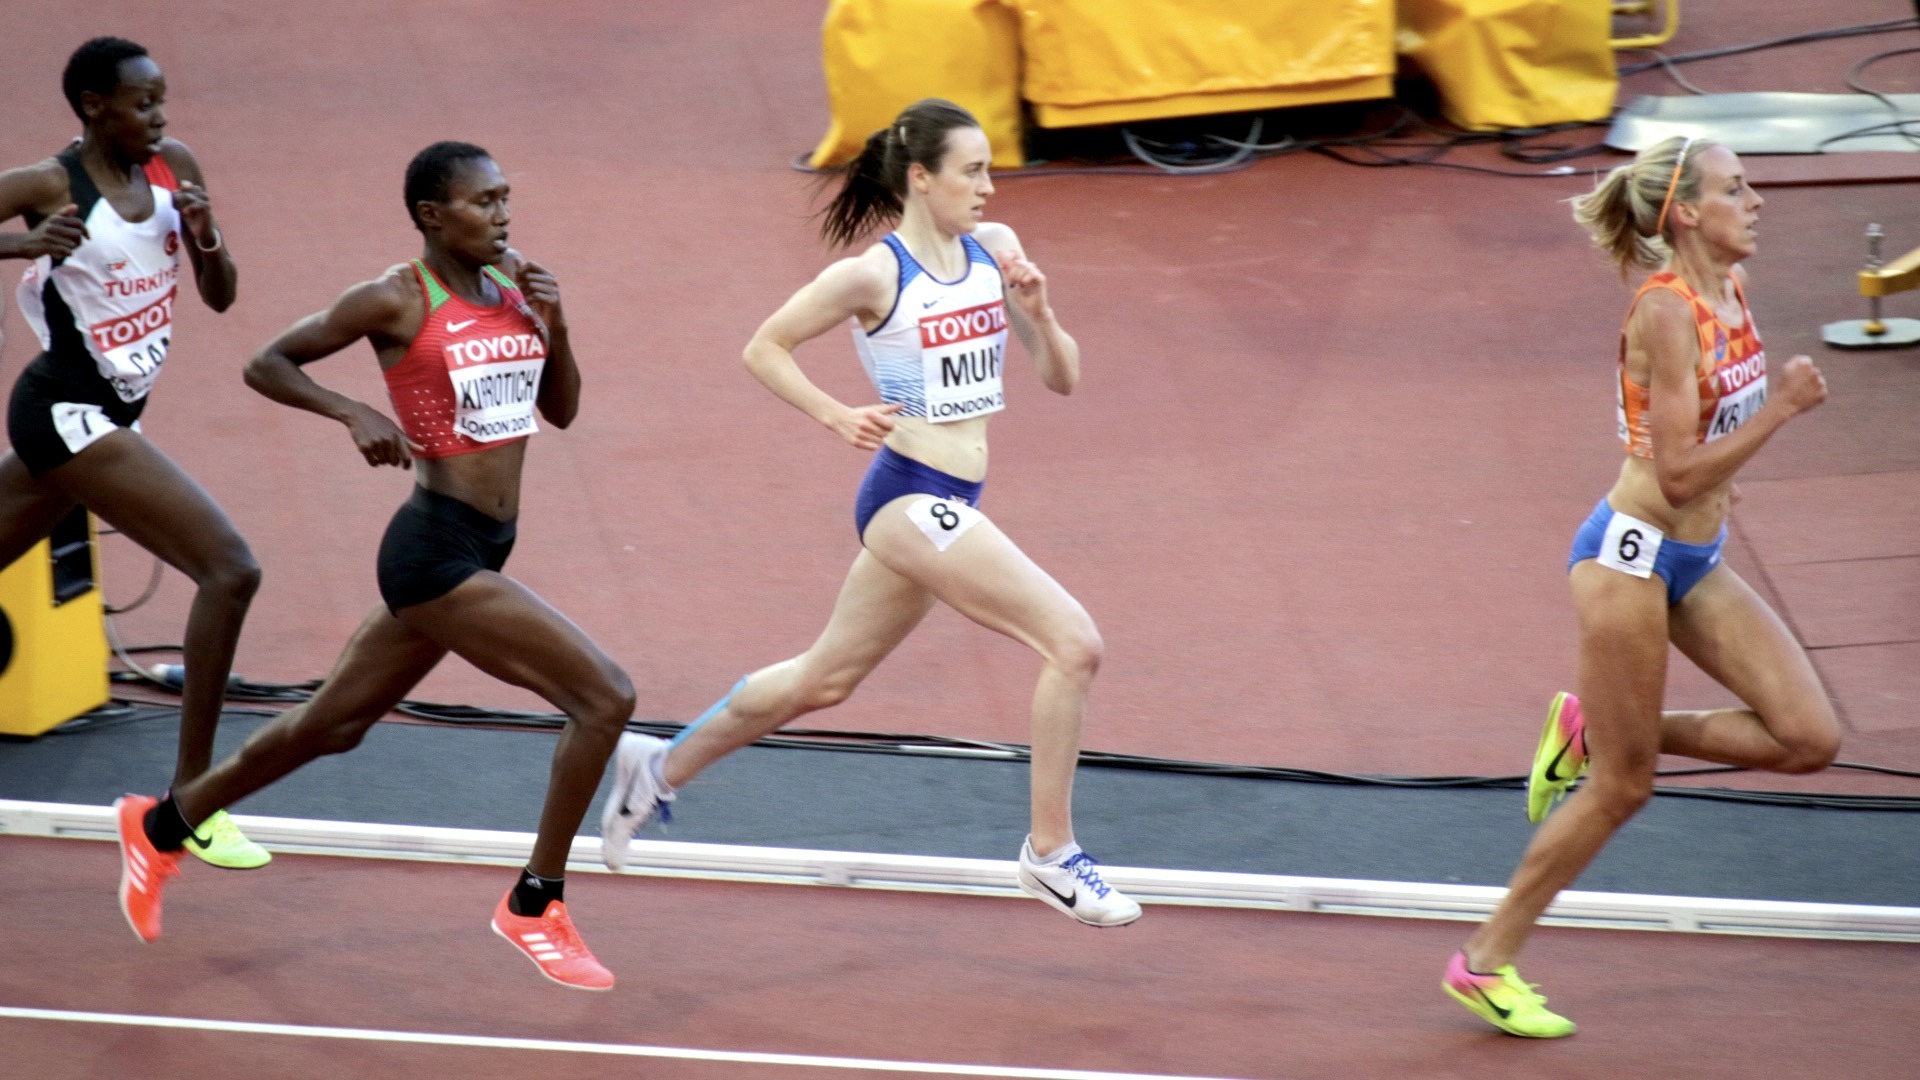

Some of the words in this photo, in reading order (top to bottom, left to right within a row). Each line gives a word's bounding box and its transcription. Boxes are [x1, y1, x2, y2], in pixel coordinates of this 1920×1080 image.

[94, 297, 172, 348] TOYOT
[129, 337, 169, 377] CA
[446, 334, 544, 365] TOYOTA
[931, 394, 997, 417] LONDON
[461, 417, 509, 436] LONDON
[930, 502, 959, 531] 8
[1619, 528, 1643, 562] 6
